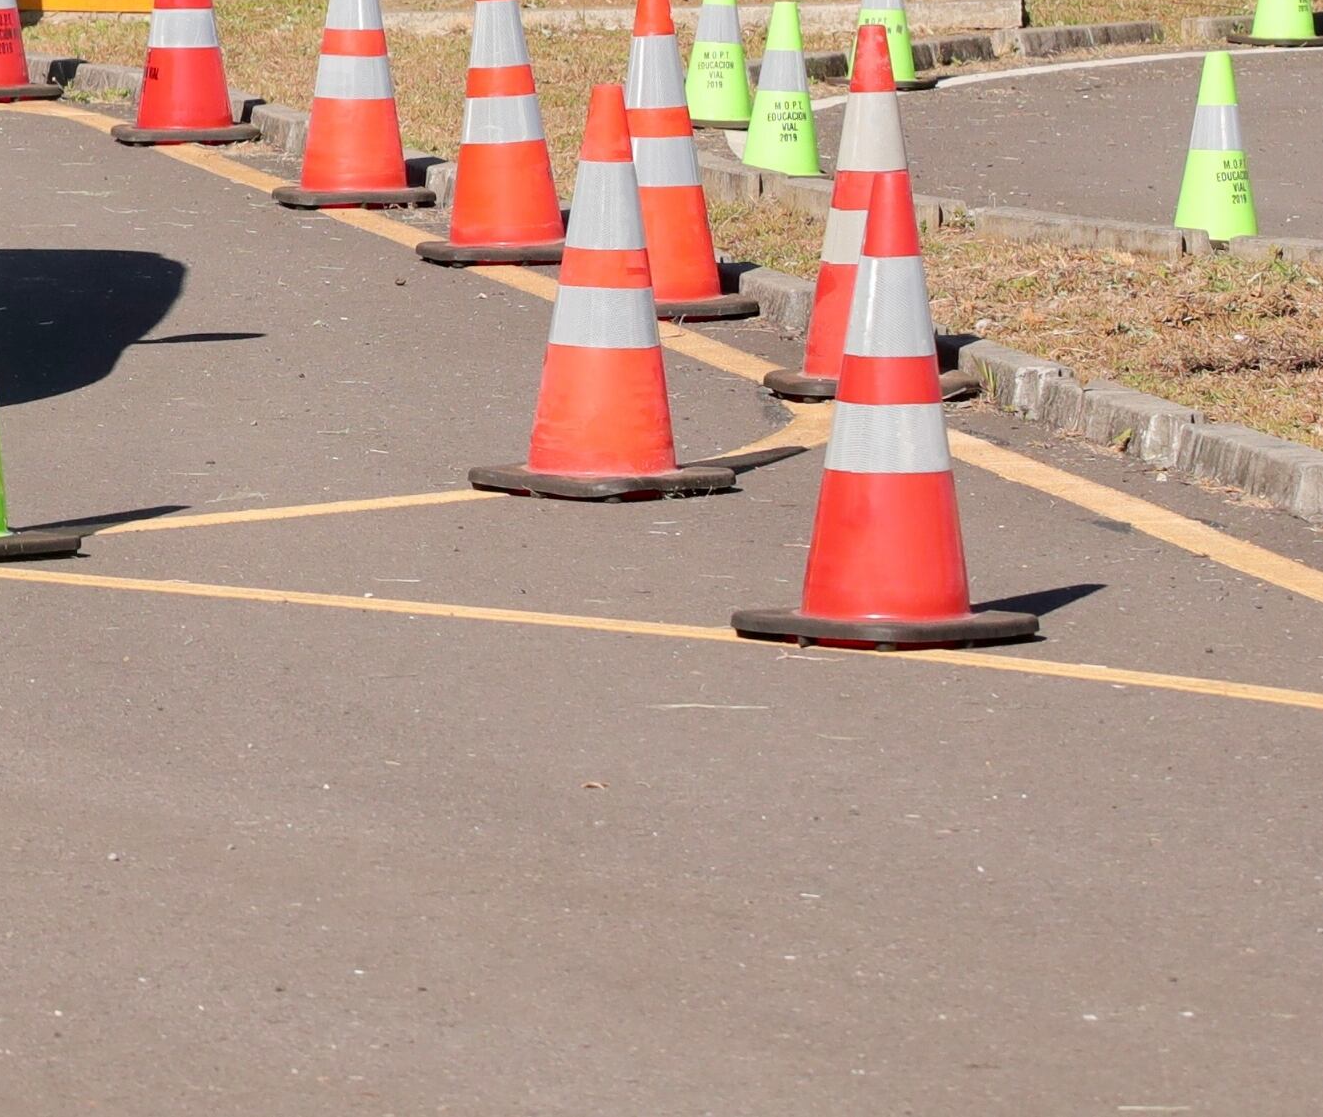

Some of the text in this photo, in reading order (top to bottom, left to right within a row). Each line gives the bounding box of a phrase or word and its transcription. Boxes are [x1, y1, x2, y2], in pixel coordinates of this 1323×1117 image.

[698, 61, 734, 70] EDUCACION
[709, 71, 723, 79] VIAL
[707, 80, 723, 89] 2019
[767, 111, 807, 122] EDUCACION
[782, 123, 798, 132] VIAL
[779, 133, 798, 143] 2019
